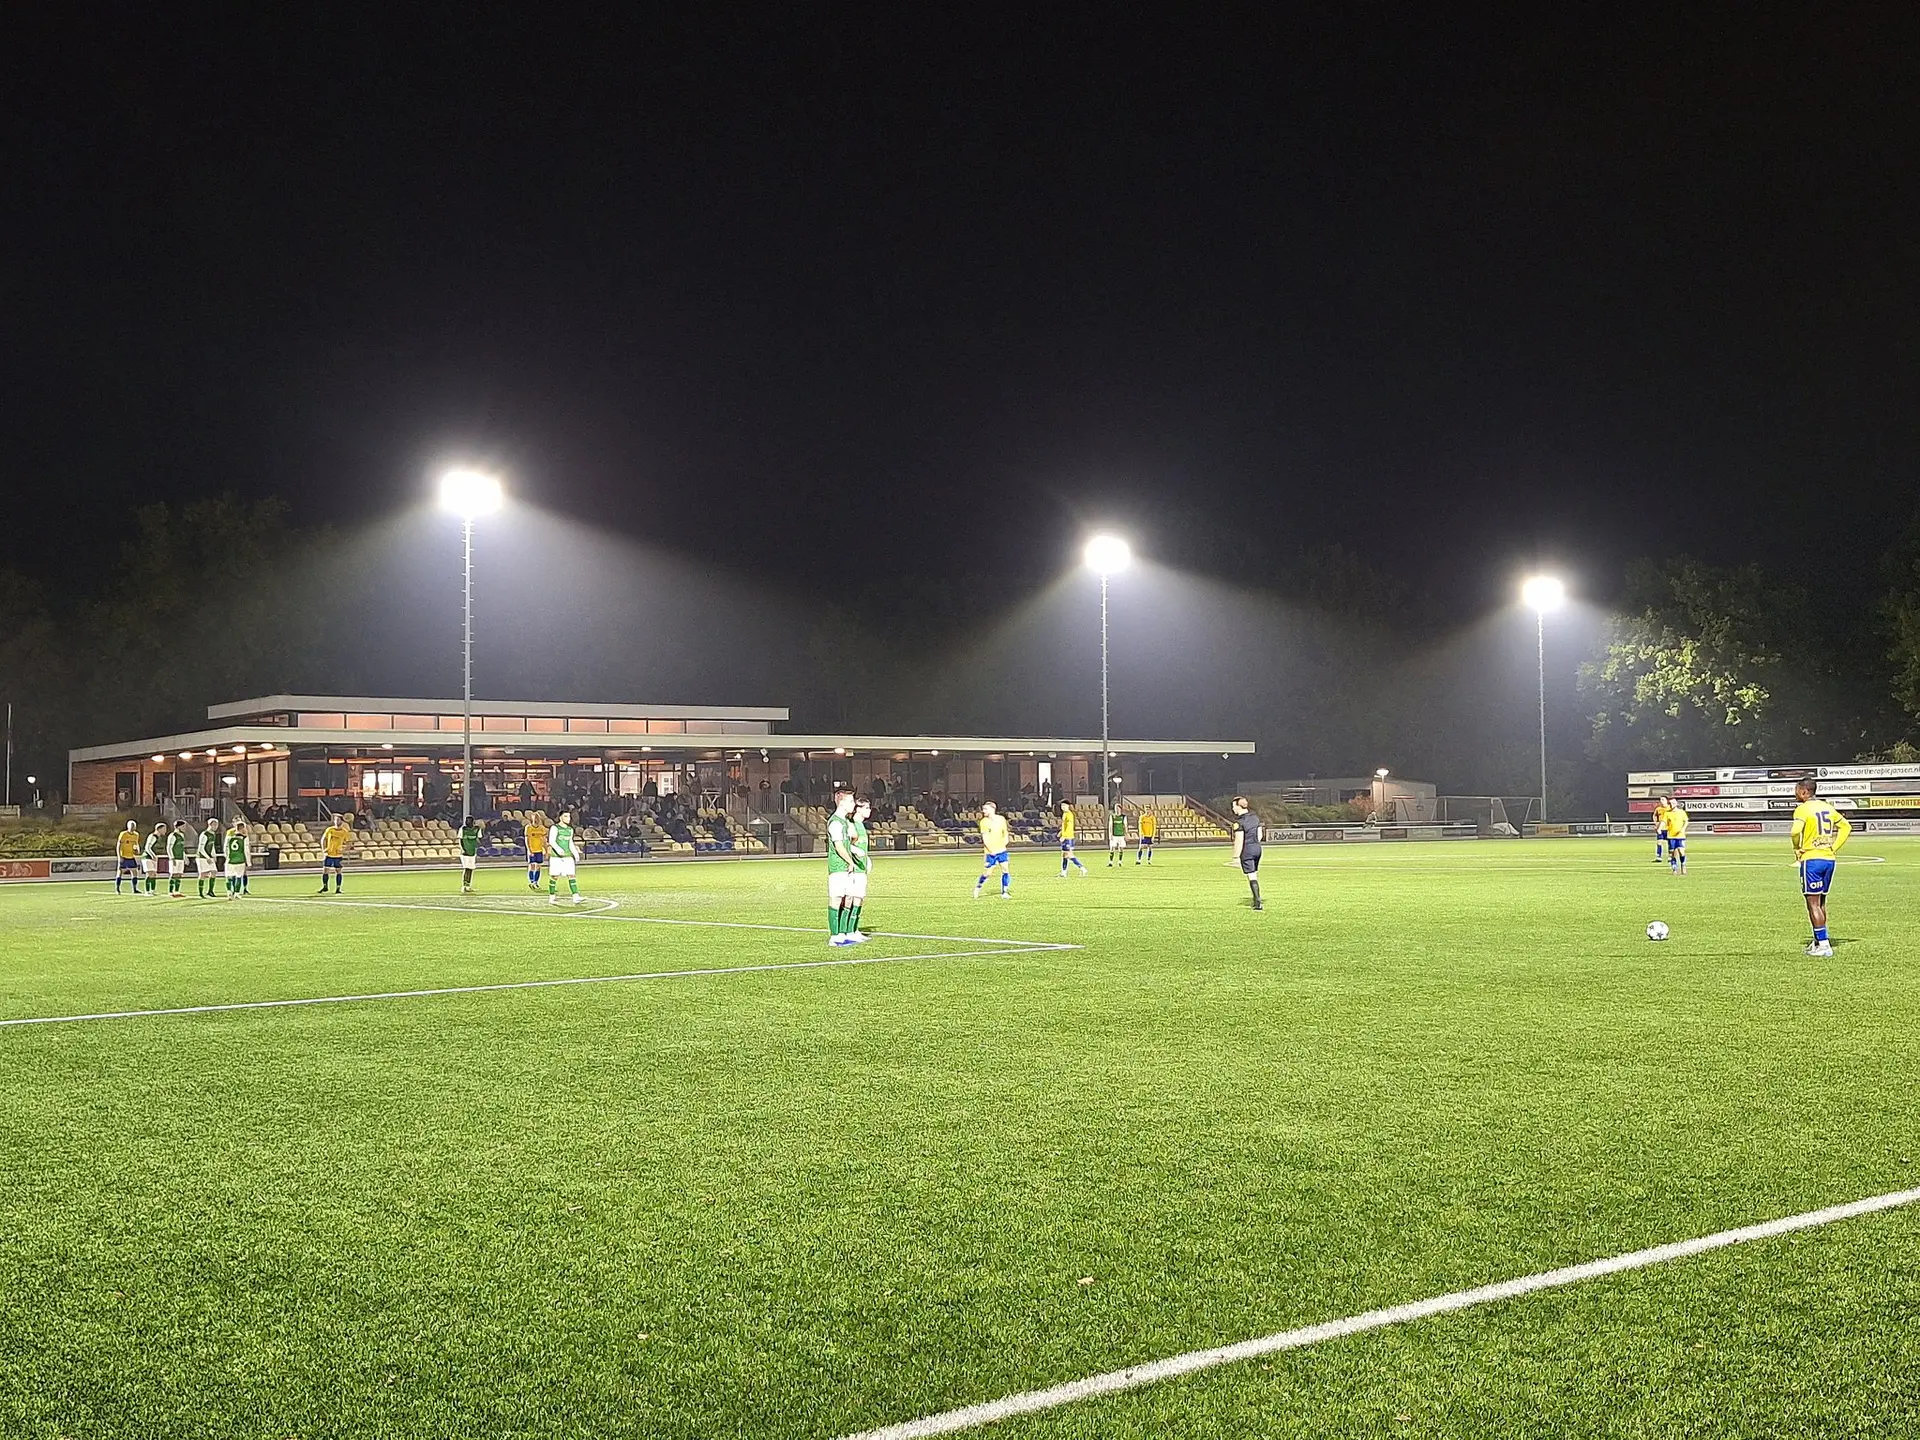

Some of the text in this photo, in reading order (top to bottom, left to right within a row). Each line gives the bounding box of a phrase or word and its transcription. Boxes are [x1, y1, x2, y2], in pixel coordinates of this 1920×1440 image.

[1871, 799, 1884, 807] EEN
[1815, 811, 1831, 835] 15
[1273, 831, 1304, 840] Rabobank
[231, 839, 239, 850] 6
